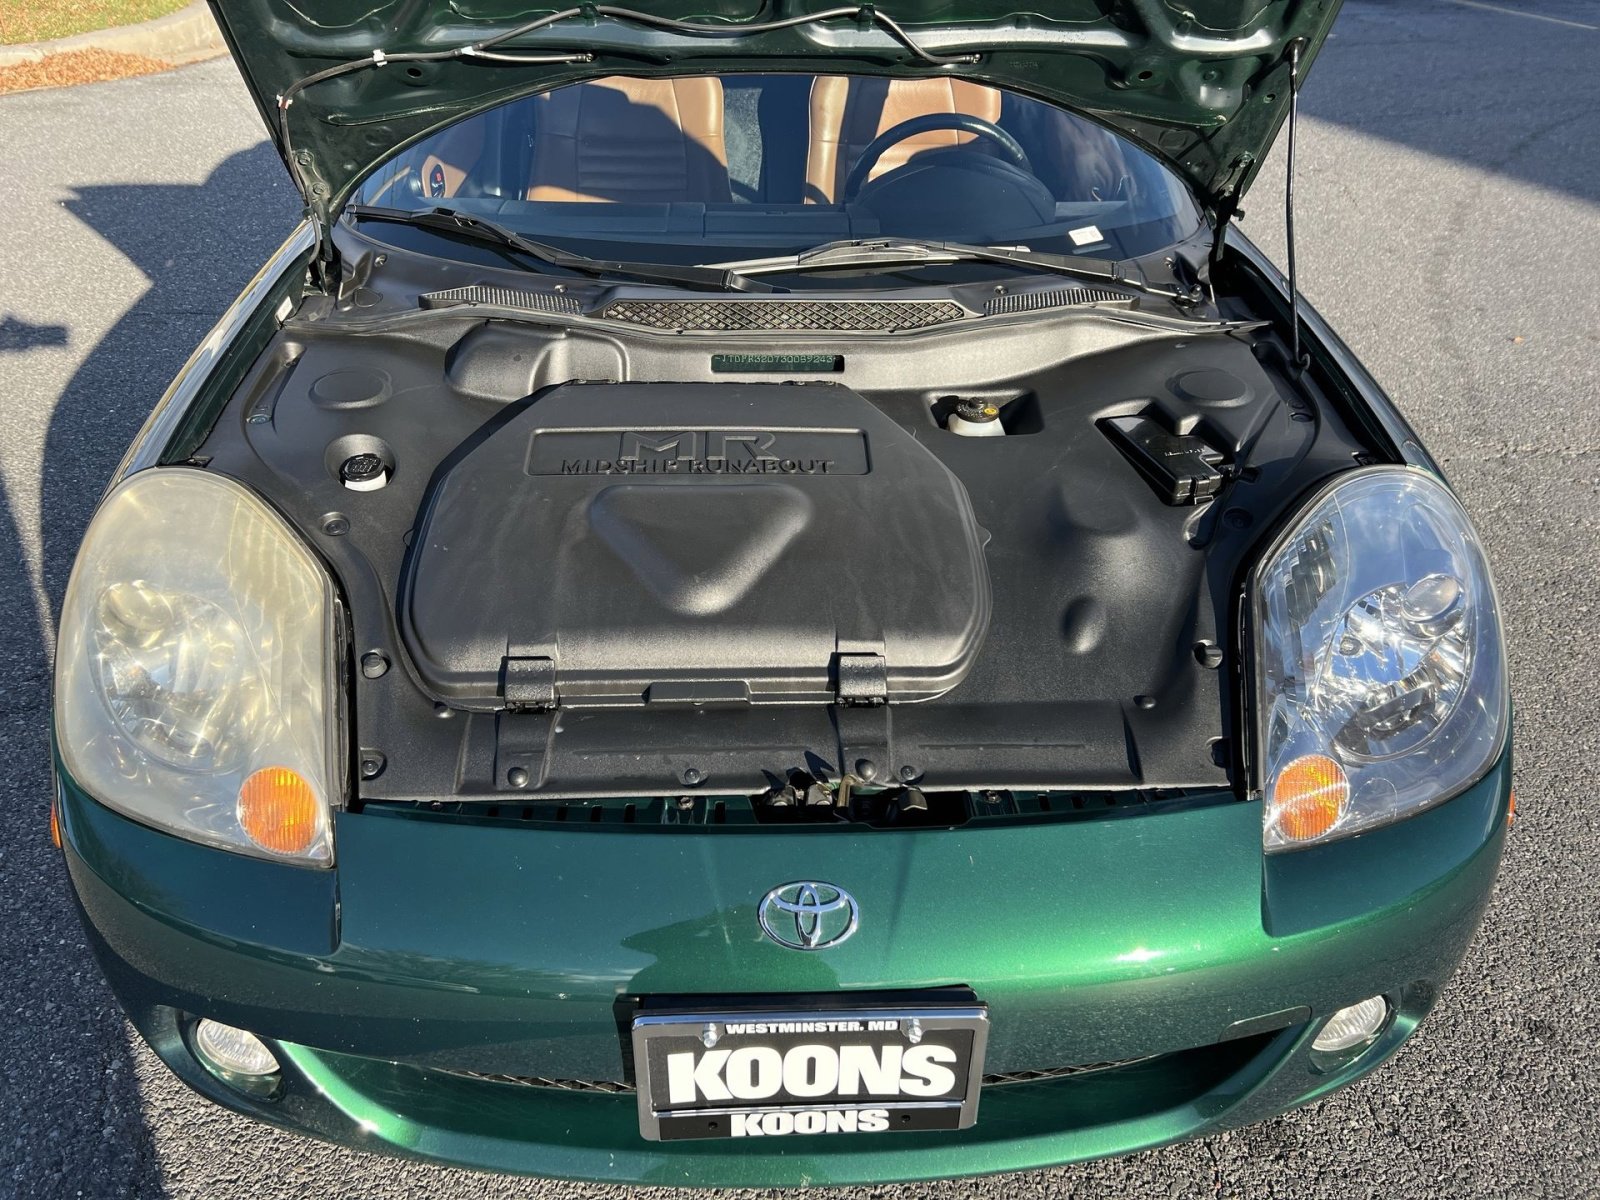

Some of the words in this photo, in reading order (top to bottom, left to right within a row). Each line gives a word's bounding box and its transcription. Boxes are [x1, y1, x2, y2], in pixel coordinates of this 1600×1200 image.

[620, 431, 780, 461] MR
[561, 459, 677, 474] MIDSHIP
[688, 459, 834, 474] RUNABOUT
[868, 1020, 899, 1032] MD
[667, 1044, 958, 1104] KOONS
[730, 1108, 890, 1137] KOONS
